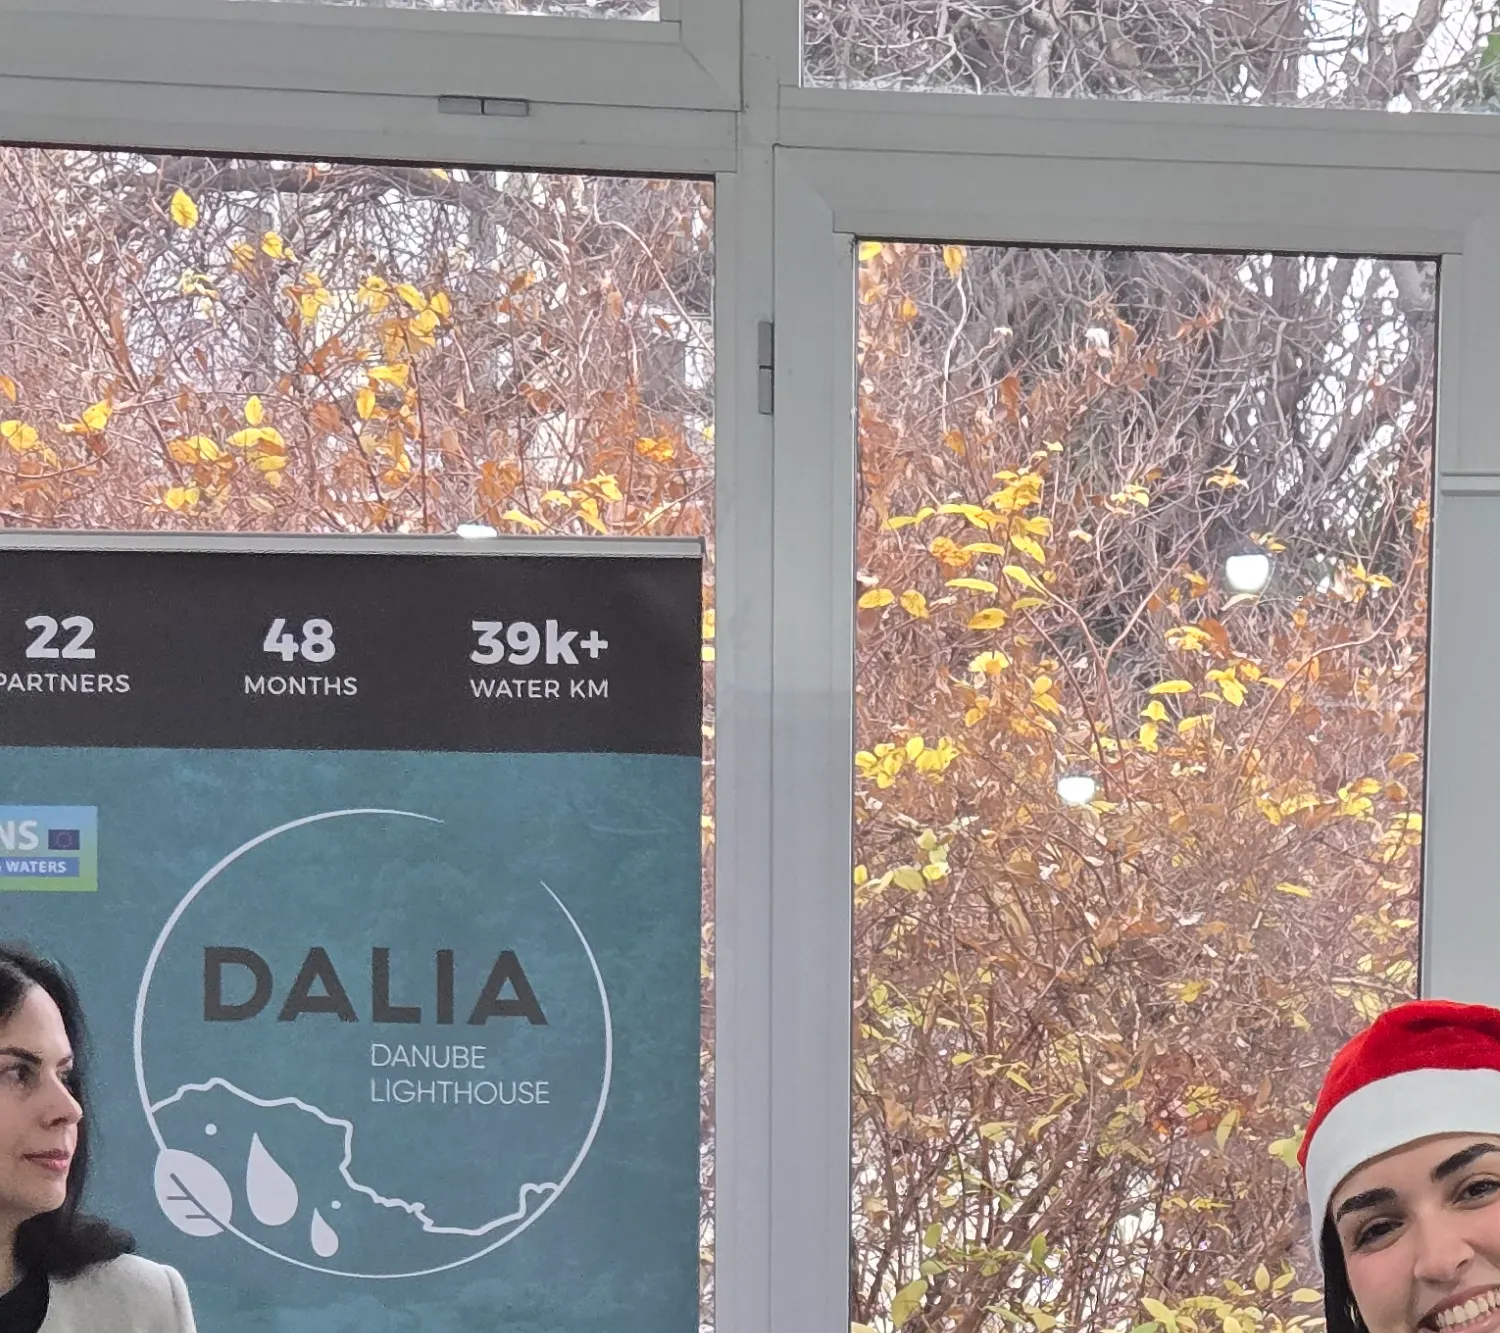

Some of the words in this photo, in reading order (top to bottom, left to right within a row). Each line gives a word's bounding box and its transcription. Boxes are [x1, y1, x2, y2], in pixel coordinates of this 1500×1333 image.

[25, 614, 96, 659] 22
[263, 618, 336, 663] 48
[470, 620, 609, 666] 39k+
[244, 675, 358, 697] MONTHS
[470, 678, 562, 699] WATER
[569, 680, 609, 700] KM
[5, 860, 68, 874] WATERS
[202, 946, 549, 1026] DALIA
[370, 1043, 486, 1070] DANUBE
[370, 1078, 550, 1106] LIGHTHOUSE
